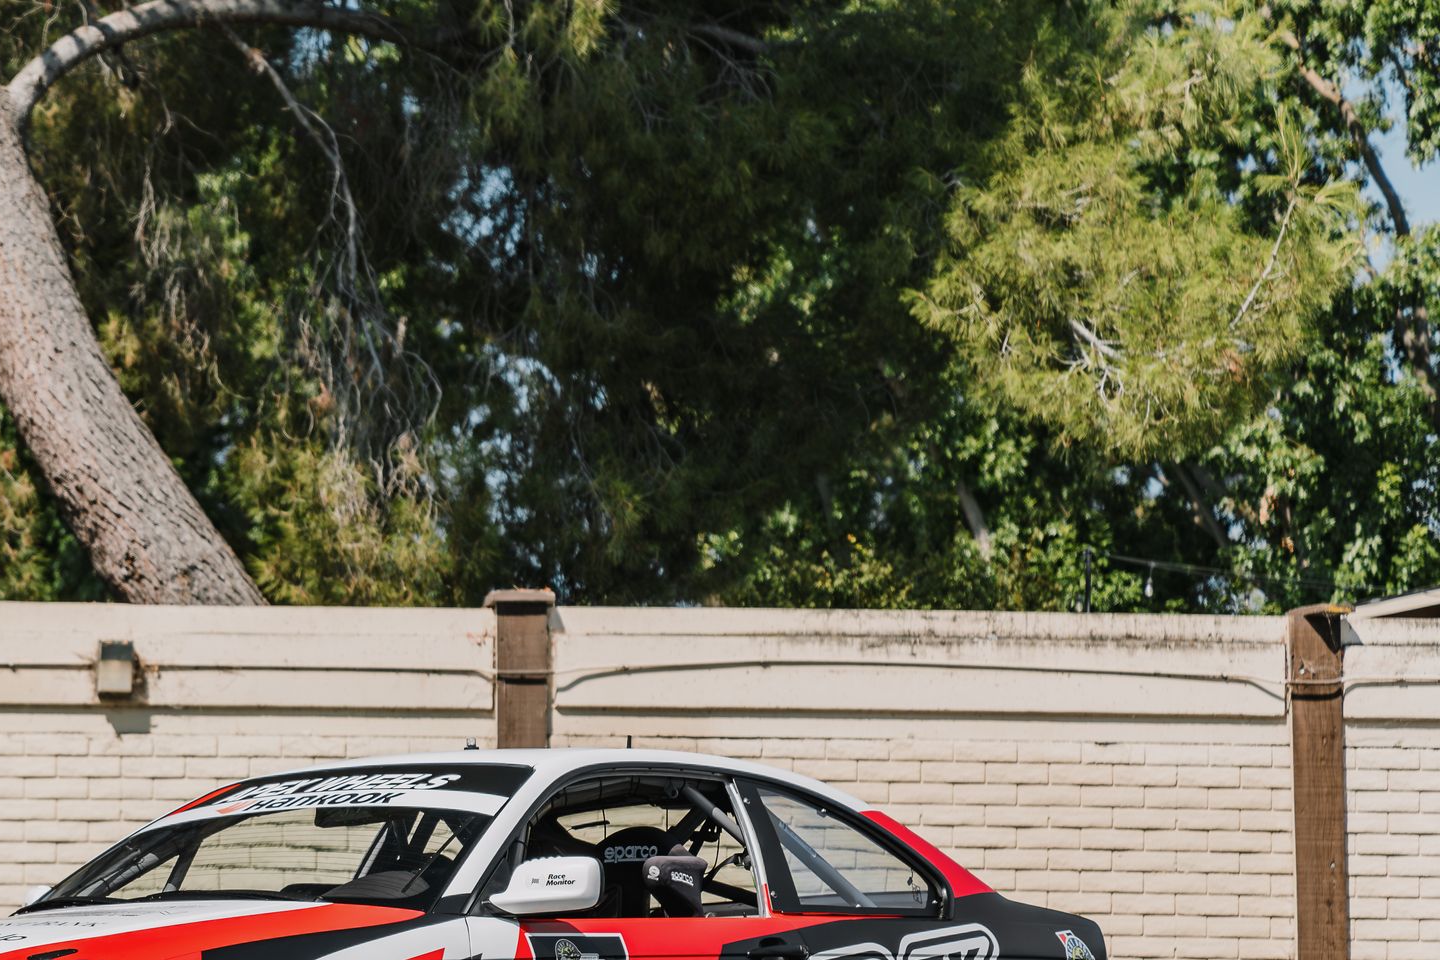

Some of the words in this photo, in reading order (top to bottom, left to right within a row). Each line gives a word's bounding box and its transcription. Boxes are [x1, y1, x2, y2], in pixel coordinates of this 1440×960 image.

[213, 778, 324, 806] APEX
[304, 773, 462, 793] WHEELS
[545, 878, 576, 886] Monitor
